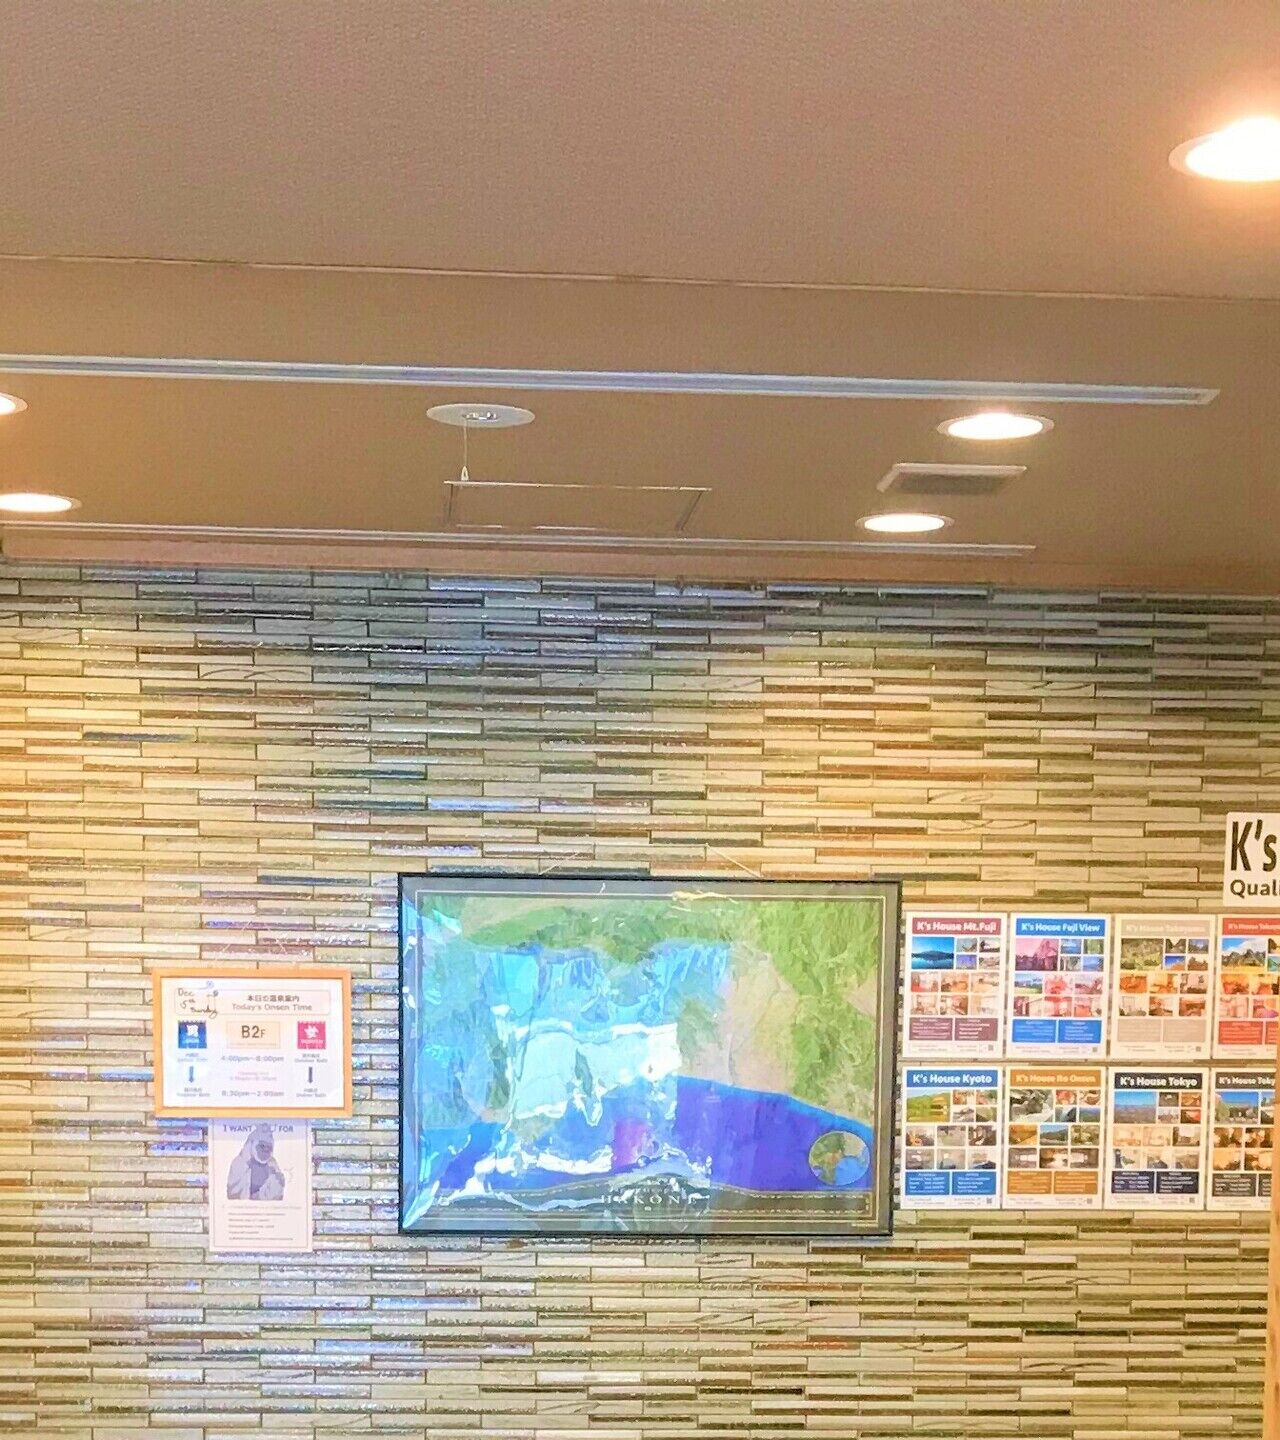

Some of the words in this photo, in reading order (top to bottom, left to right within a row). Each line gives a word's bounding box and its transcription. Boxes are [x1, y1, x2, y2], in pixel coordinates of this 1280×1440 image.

[1231, 819, 1277, 872] K's
[918, 921, 931, 931] K's
[933, 921, 961, 931] House
[963, 921, 996, 933] Mt.Fuji
[1021, 923, 1034, 931] K's
[1036, 923, 1060, 932] House
[1062, 923, 1078, 933] Fuji
[1079, 923, 1100, 932] View
[232, 1003, 261, 1012] Today's
[264, 1004, 289, 1012] Onsen
[241, 1025, 266, 1039] B2F
[912, 1074, 927, 1084] K's
[929, 1074, 961, 1084] House
[963, 1074, 992, 1085] Kyoto
[1120, 1077, 1134, 1086] K's
[1137, 1077, 1166, 1086] House
[1168, 1077, 1198, 1087] Tokyo
[1219, 1076, 1230, 1084] K's
[1232, 1076, 1255, 1085] House
[229, 1124, 252, 1133] WANT
[278, 1124, 294, 1133] FOR
